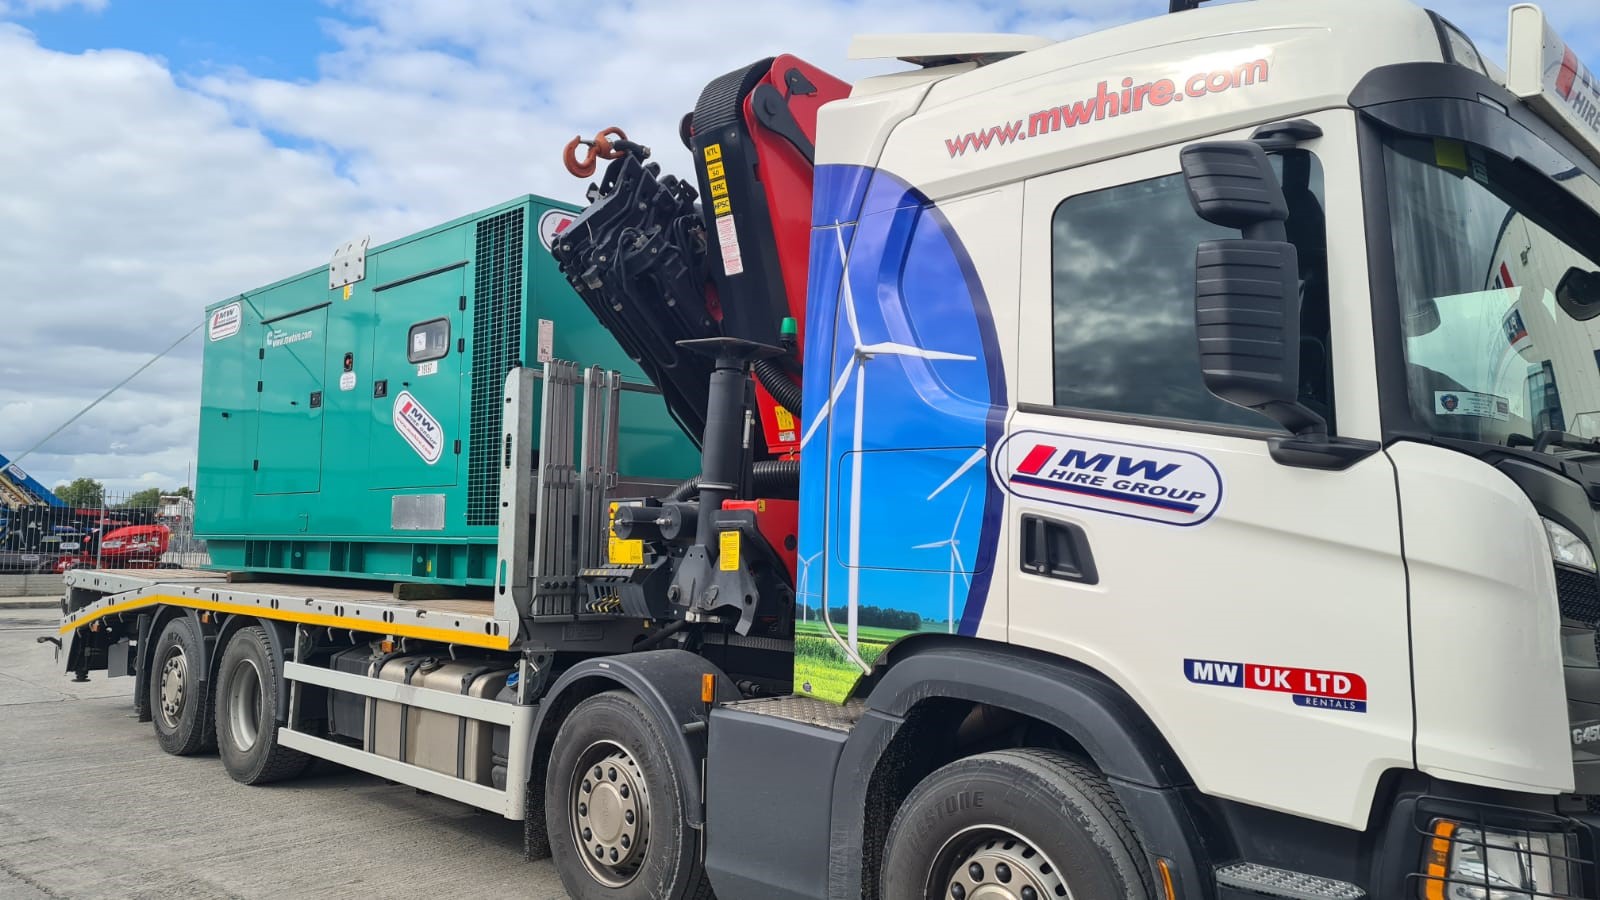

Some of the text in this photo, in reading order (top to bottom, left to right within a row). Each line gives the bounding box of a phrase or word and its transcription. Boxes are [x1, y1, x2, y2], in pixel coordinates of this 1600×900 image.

[945, 58, 1268, 158] www.mwhire.com
[411, 407, 435, 432] MW
[1058, 449, 1182, 481] MW
[1048, 469, 1206, 502] HIRE GROUP
[1193, 662, 1352, 694] MW UK LTD
[1305, 697, 1356, 710] RENTALS
[1572, 724, 1600, 745] G45
